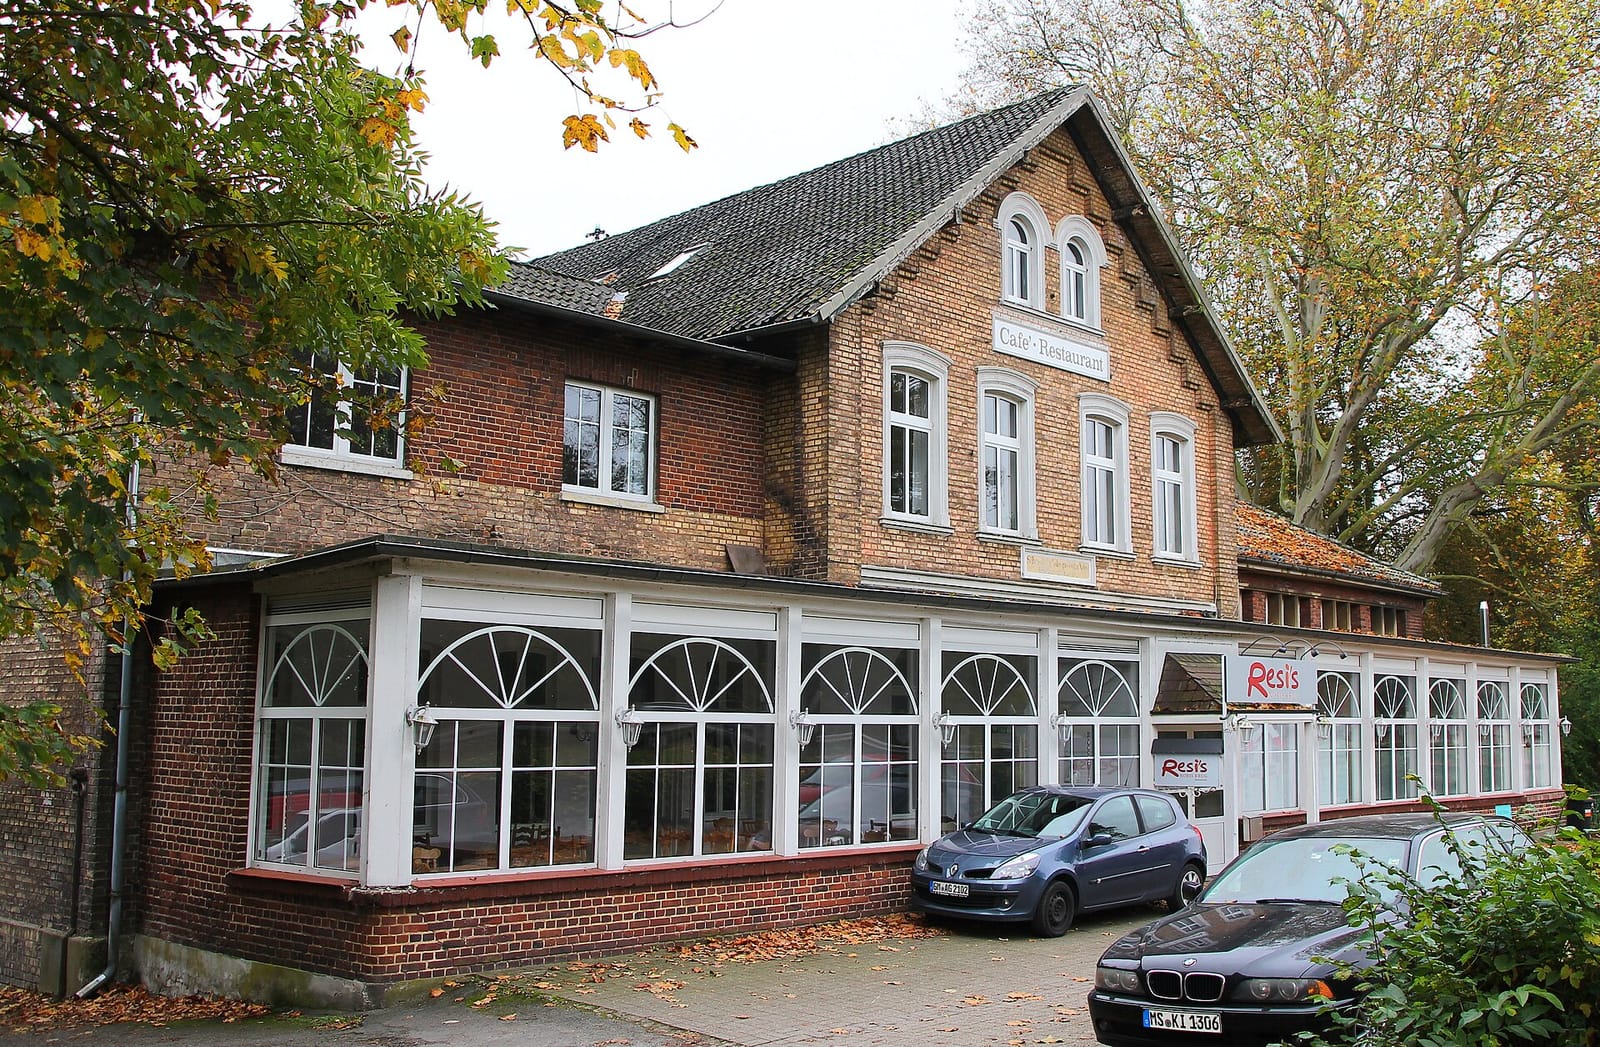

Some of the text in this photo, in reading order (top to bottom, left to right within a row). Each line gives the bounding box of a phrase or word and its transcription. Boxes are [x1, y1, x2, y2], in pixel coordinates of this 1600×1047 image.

[1039, 338, 1104, 372] Restaurant
[1247, 662, 1299, 698] Resi's
[1162, 759, 1208, 777] Resi's
[1189, 1015, 1219, 1031] 1306
